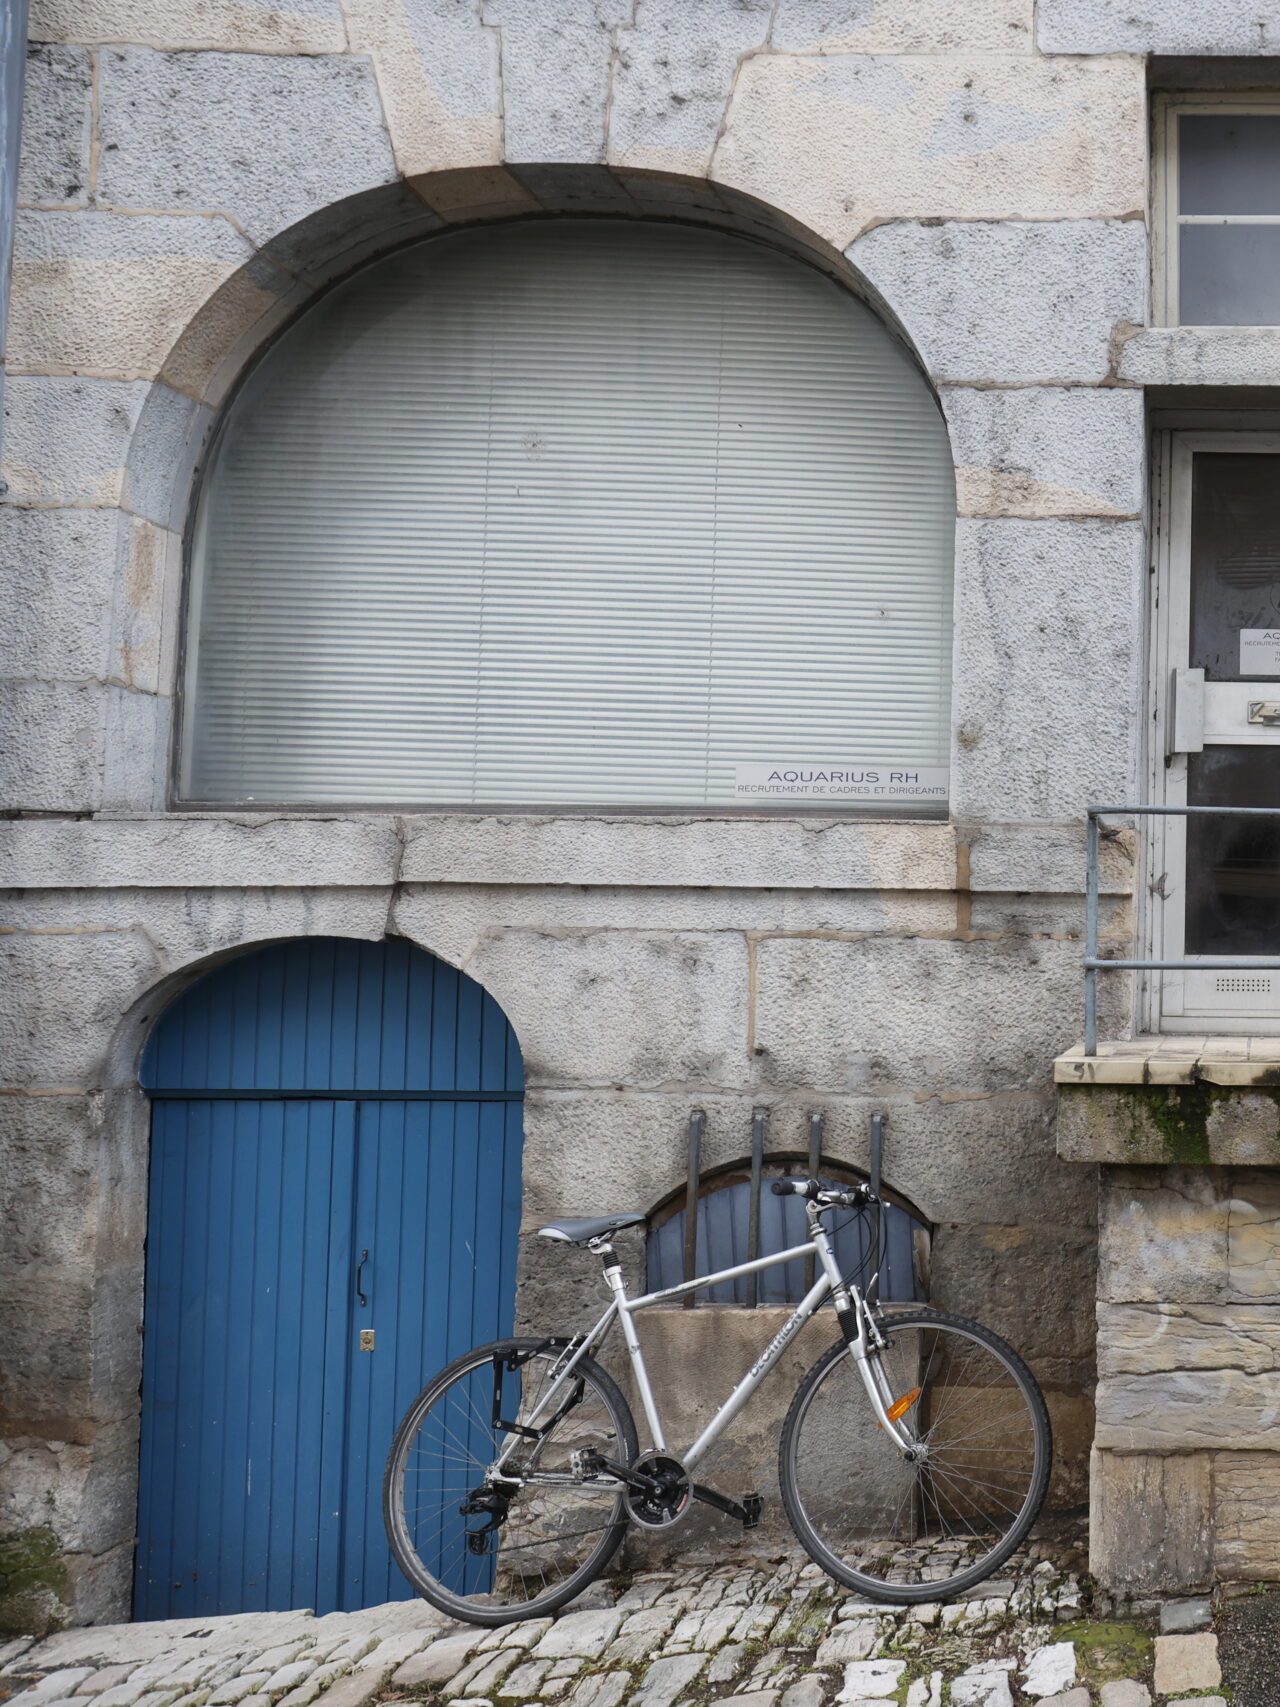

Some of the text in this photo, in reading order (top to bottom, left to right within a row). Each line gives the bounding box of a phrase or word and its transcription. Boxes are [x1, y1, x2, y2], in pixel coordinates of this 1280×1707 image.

[767, 771, 919, 783] AQUARIUS RH
[737, 784, 946, 795] RECRUTEMENT DE CADRES ET DIRIGEANTS
[748, 1311, 803, 1378] DECATHLON
